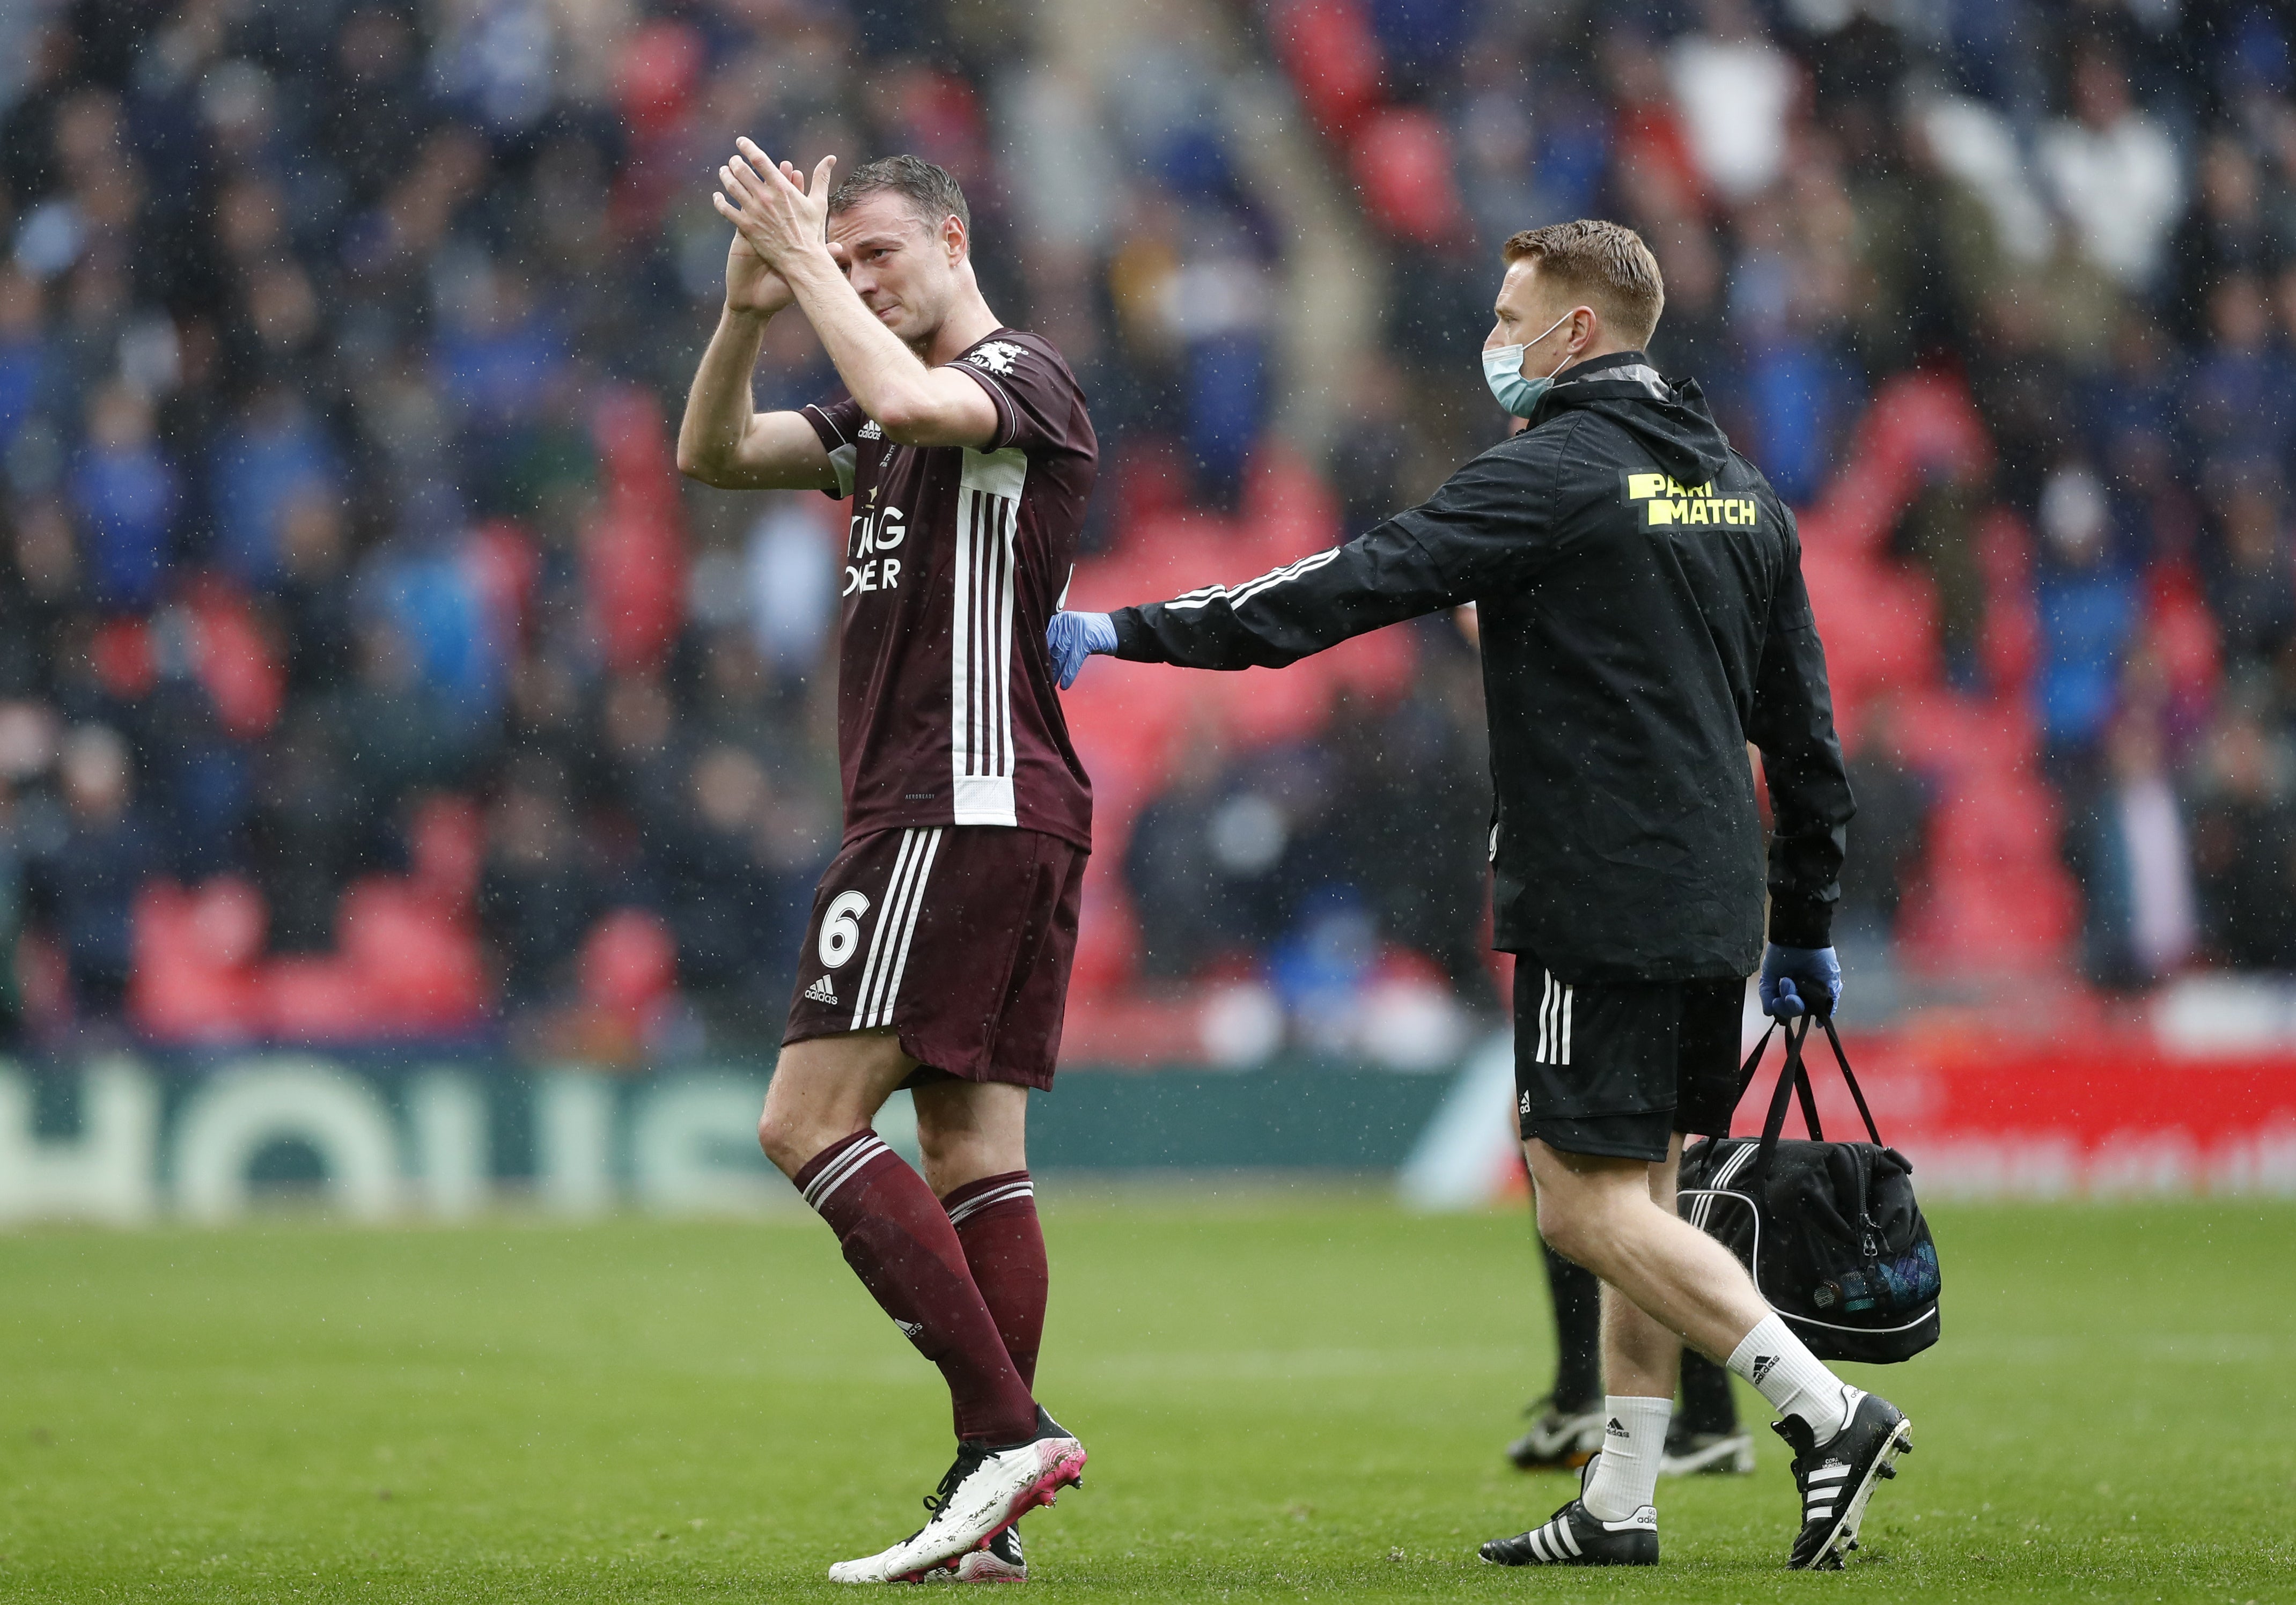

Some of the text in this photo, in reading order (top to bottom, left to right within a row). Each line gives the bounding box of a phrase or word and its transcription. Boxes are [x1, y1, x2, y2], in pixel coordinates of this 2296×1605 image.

[858, 429, 881, 440] adidas
[1649, 499, 1755, 526] MATCH
[819, 890, 870, 968] 6
[805, 989, 838, 1005] adidas
[1754, 1355, 1780, 1385] adidas
